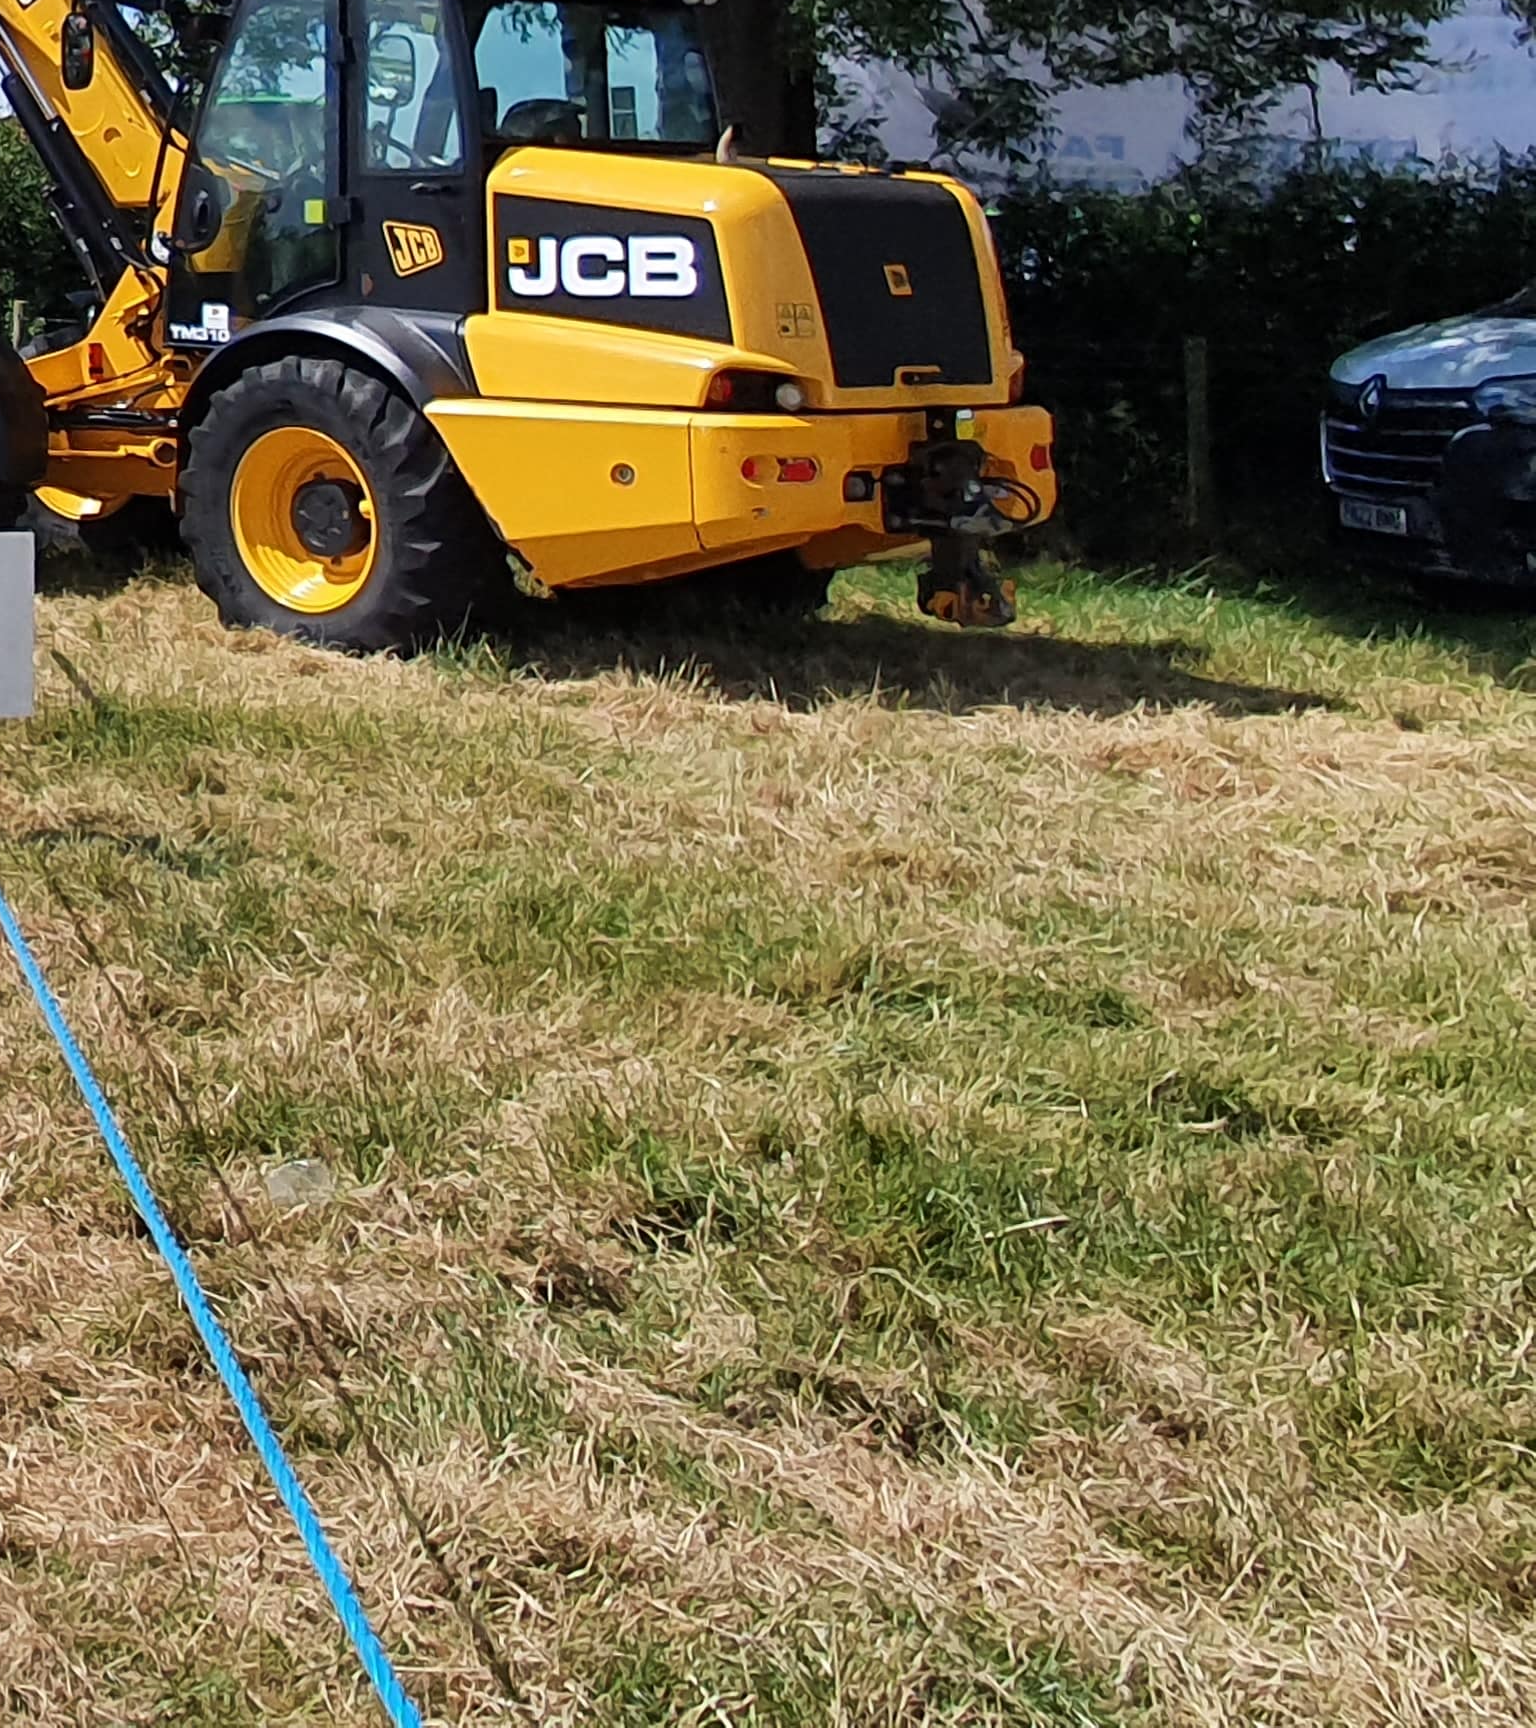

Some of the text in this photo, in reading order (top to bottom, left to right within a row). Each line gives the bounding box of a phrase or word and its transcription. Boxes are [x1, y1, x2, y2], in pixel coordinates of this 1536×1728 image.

[393, 228, 437, 270] JCB
[508, 235, 697, 297] JCB
[169, 323, 230, 343] TM310
